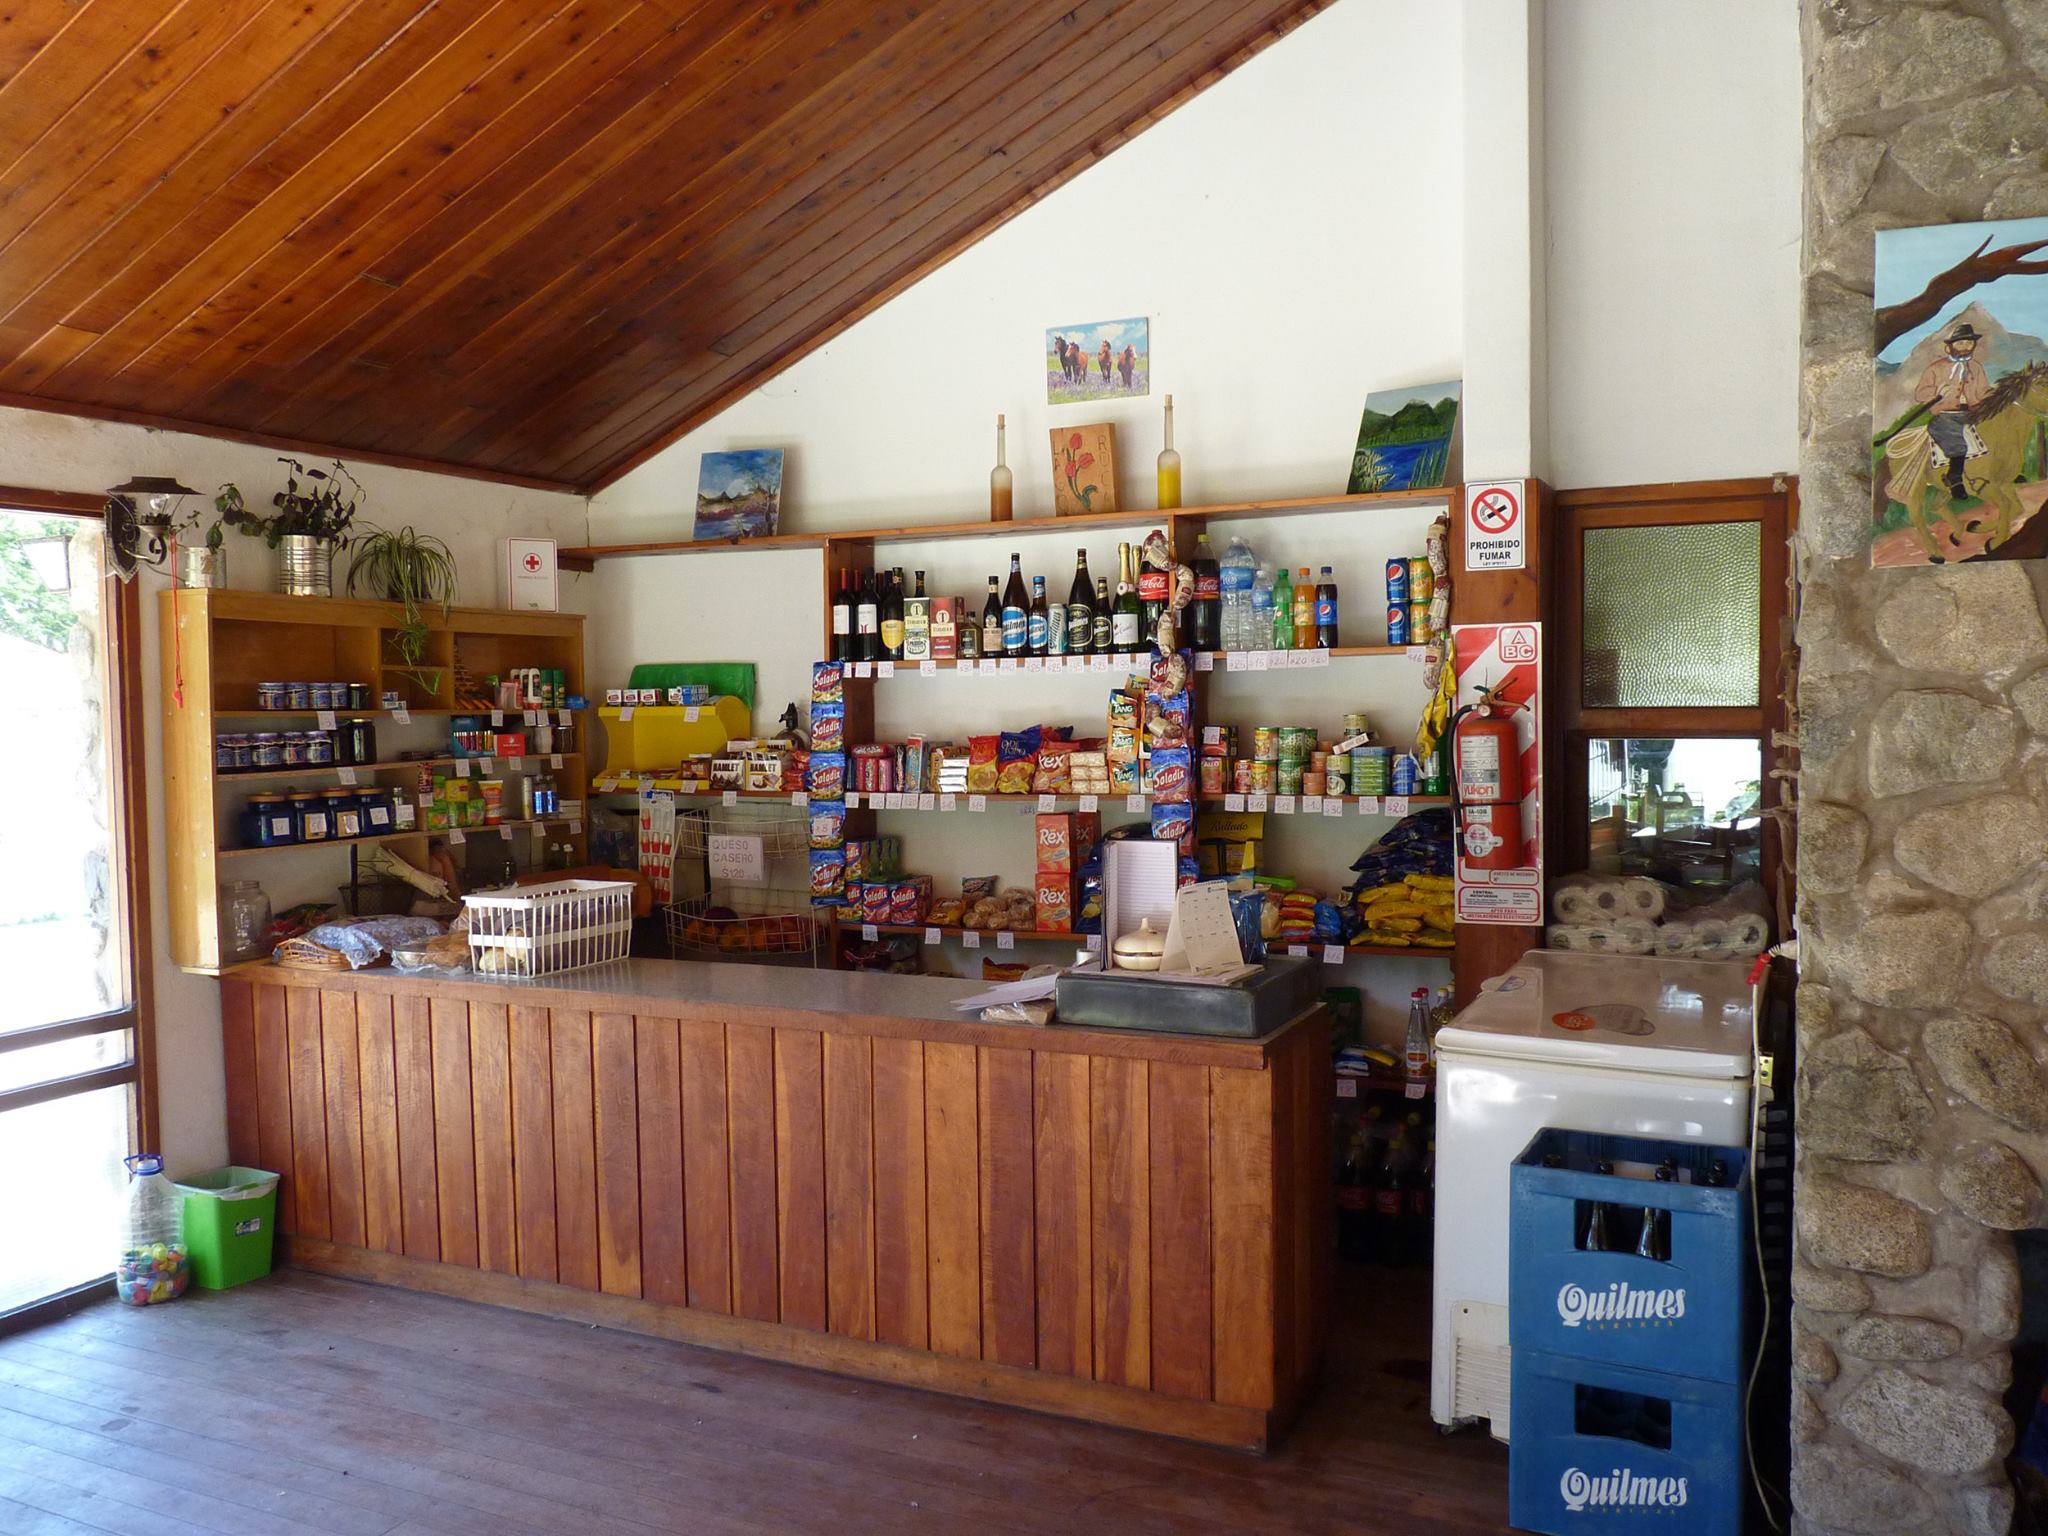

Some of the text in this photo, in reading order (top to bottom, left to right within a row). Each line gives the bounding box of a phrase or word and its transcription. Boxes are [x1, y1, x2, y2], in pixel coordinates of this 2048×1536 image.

[1470, 540, 1520, 550] PROHIBIDO
[1479, 551, 1511, 560] FUMAR
[814, 668, 840, 688] Saladix
[812, 719, 841, 737] Saladix
[713, 763, 740, 772] HAMLET
[812, 768, 841, 786] Saladix
[1154, 770, 1185, 788] Saladix
[711, 840, 749, 850] QUESO
[1040, 828, 1065, 845] Rex
[712, 853, 754, 864] CASERO
[863, 887, 887, 903] Saladix
[891, 887, 916, 905] Saladix
[1039, 888, 1066, 905] Rex
[1557, 1282, 1686, 1327] Quilmes
[1560, 1467, 1688, 1512] Quilmes
